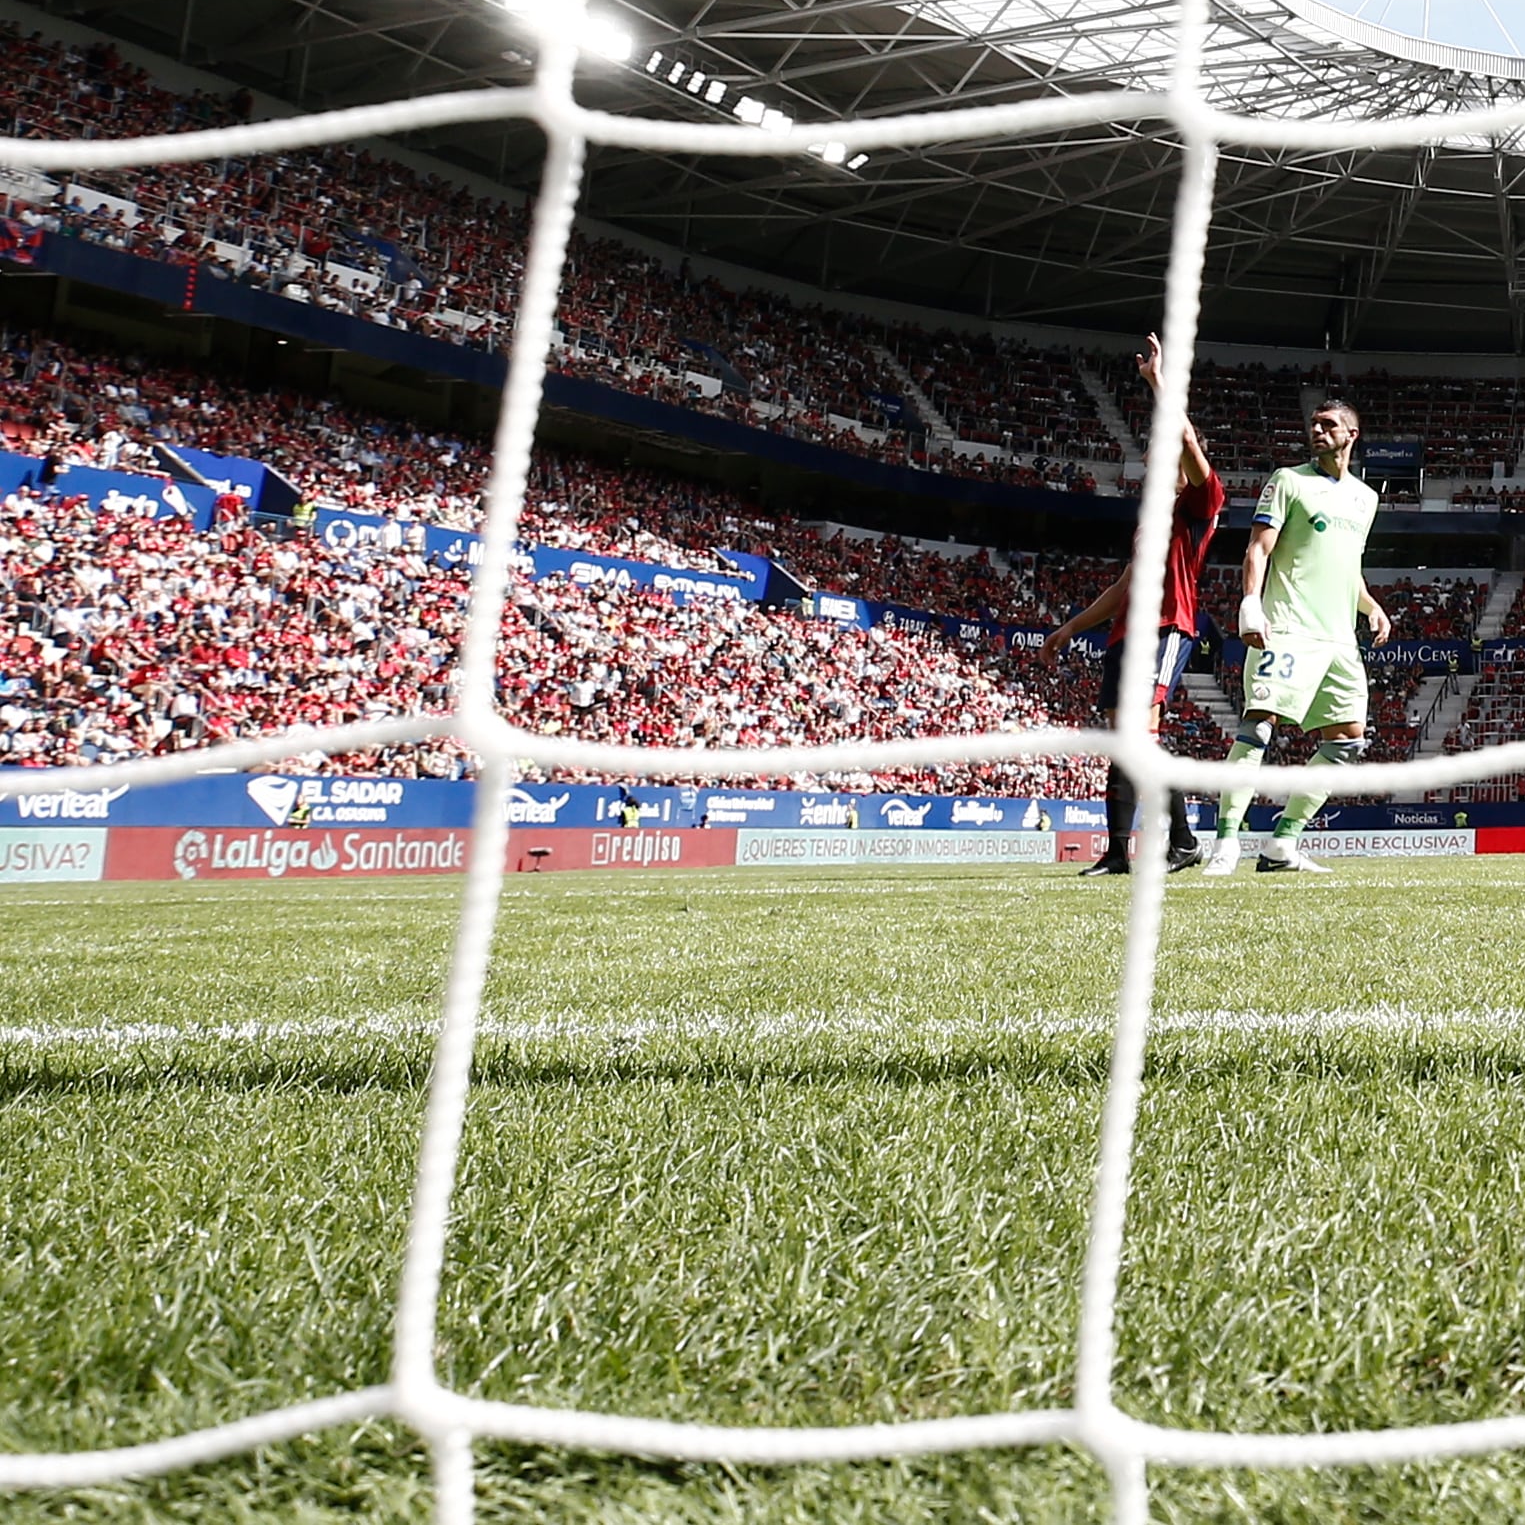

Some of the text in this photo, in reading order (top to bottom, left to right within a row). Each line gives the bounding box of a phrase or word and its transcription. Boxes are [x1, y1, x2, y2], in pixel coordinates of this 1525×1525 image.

[1257, 650, 1295, 679] 23
[301, 780, 404, 805] EL SADAR
[1394, 813, 1438, 825] Noticias
[210, 830, 309, 877] LaLiga
[611, 831, 680, 866] redpiso
[742, 836, 1052, 863] ¿QUIERES TENER UN ASESOR INMOBILIARIO EN EXCLUSIVA?
[1345, 837, 1365, 851] EN
[1372, 835, 1467, 850] EXCLUSIVA?
